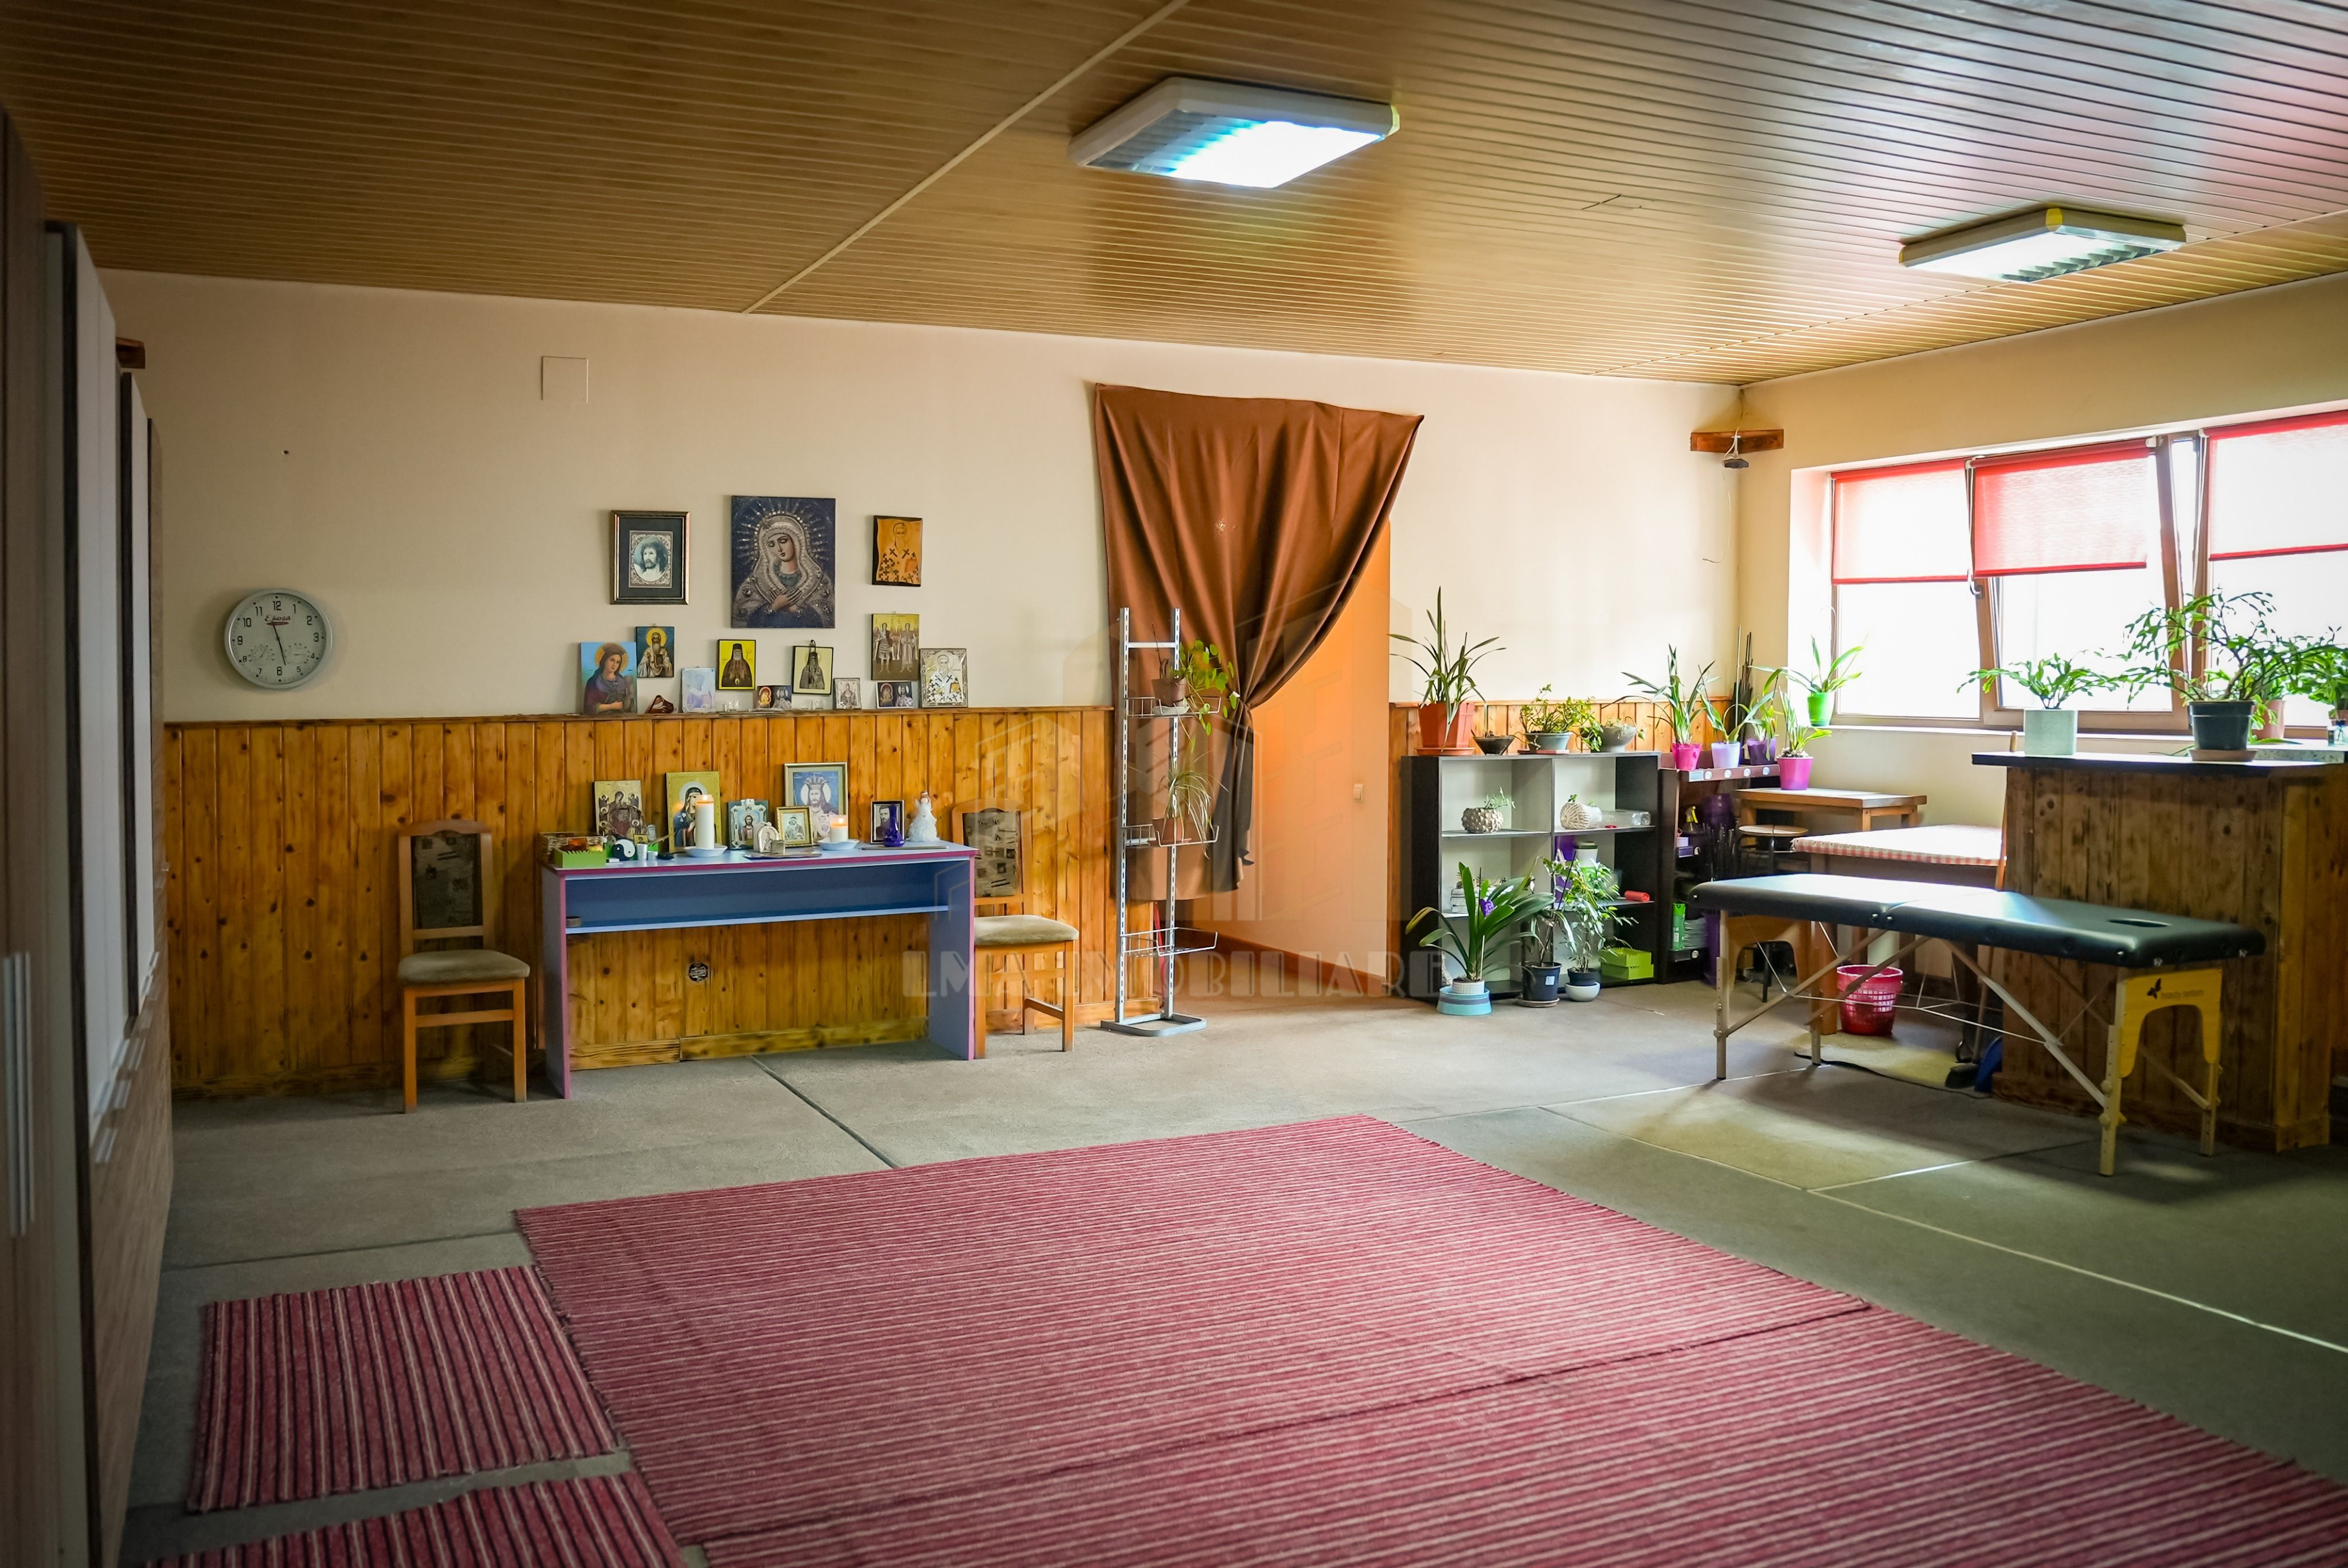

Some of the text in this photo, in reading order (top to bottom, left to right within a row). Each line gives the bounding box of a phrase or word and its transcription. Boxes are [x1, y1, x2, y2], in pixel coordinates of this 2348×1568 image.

[273, 601, 281, 611] 12
[292, 604, 296, 614] 1
[255, 606, 263, 616] 11
[242, 617, 252, 628] 10
[307, 616, 312, 625] 2
[237, 636, 243, 645] 9
[313, 633, 319, 642] 3
[276, 667, 283, 676] 6
